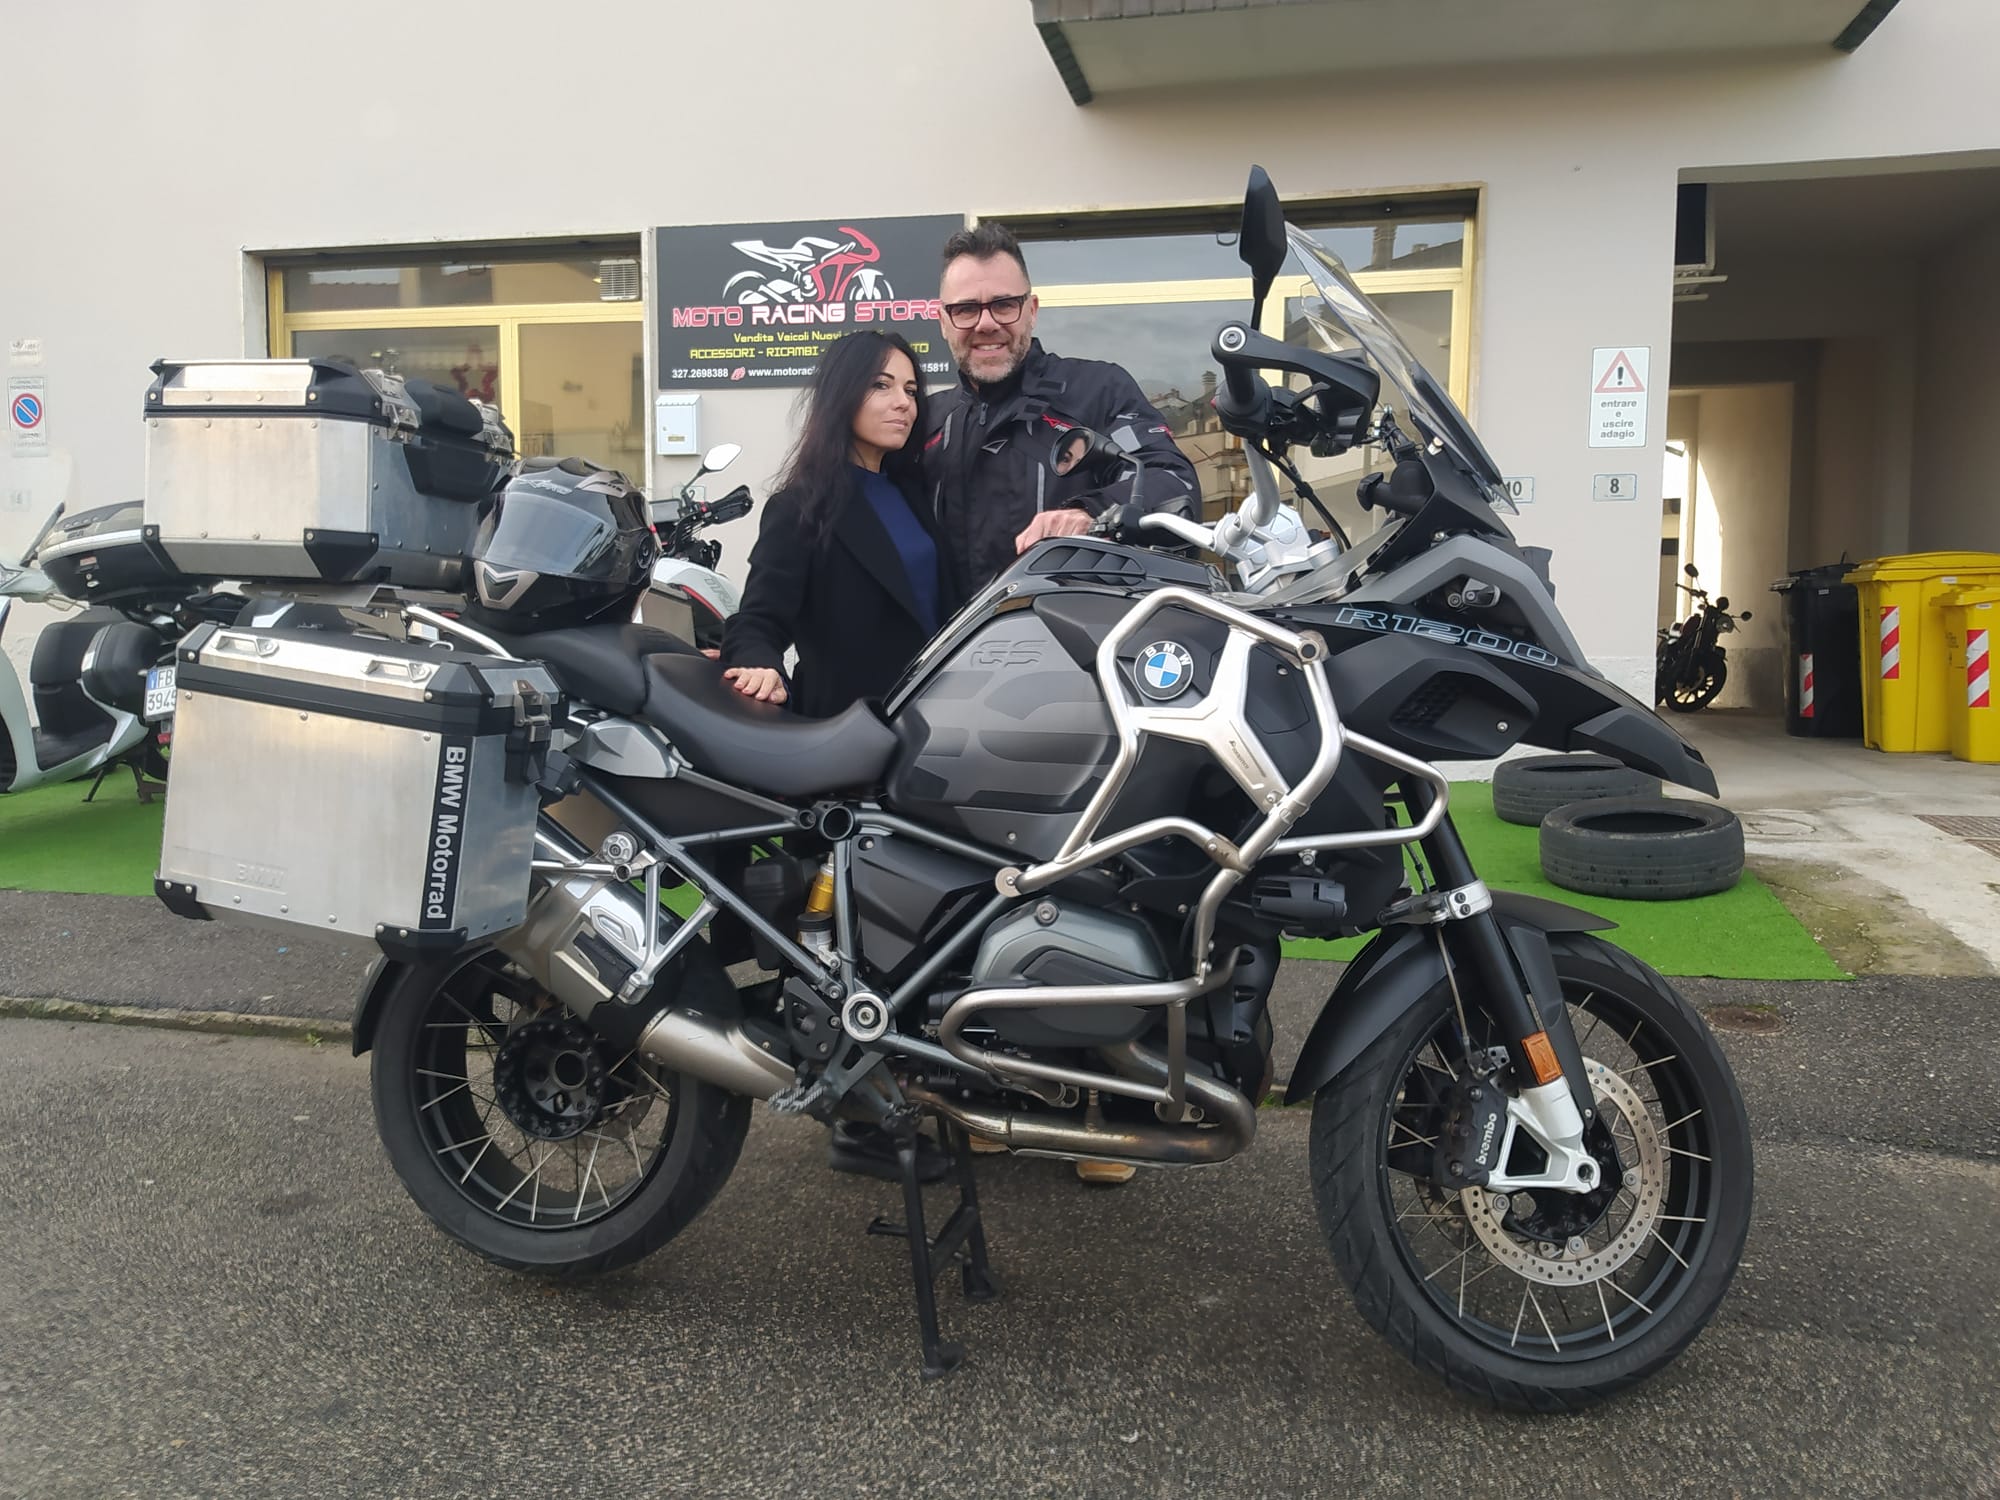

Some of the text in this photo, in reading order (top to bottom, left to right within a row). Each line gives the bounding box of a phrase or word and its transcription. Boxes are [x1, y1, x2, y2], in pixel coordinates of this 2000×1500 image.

[672, 306, 743, 328] MOTO
[751, 303, 846, 325] RACING
[733, 333, 774, 343] Vendita
[777, 331, 809, 342] Veicoli
[690, 348, 756, 359] ACCESSORI
[766, 346, 819, 357] RICAMBI
[672, 369, 729, 379] 327.2698388
[1601, 400, 1637, 408] entrare
[1602, 420, 1634, 428] uscire
[1600, 430, 1635, 439] adagio
[1610, 478, 1619, 494] 8
[1335, 607, 1558, 666] R1200
[1144, 643, 1191, 666] BMW
[426, 746, 466, 919] BMW Motorrad
[1475, 1113, 1498, 1165] brembo
